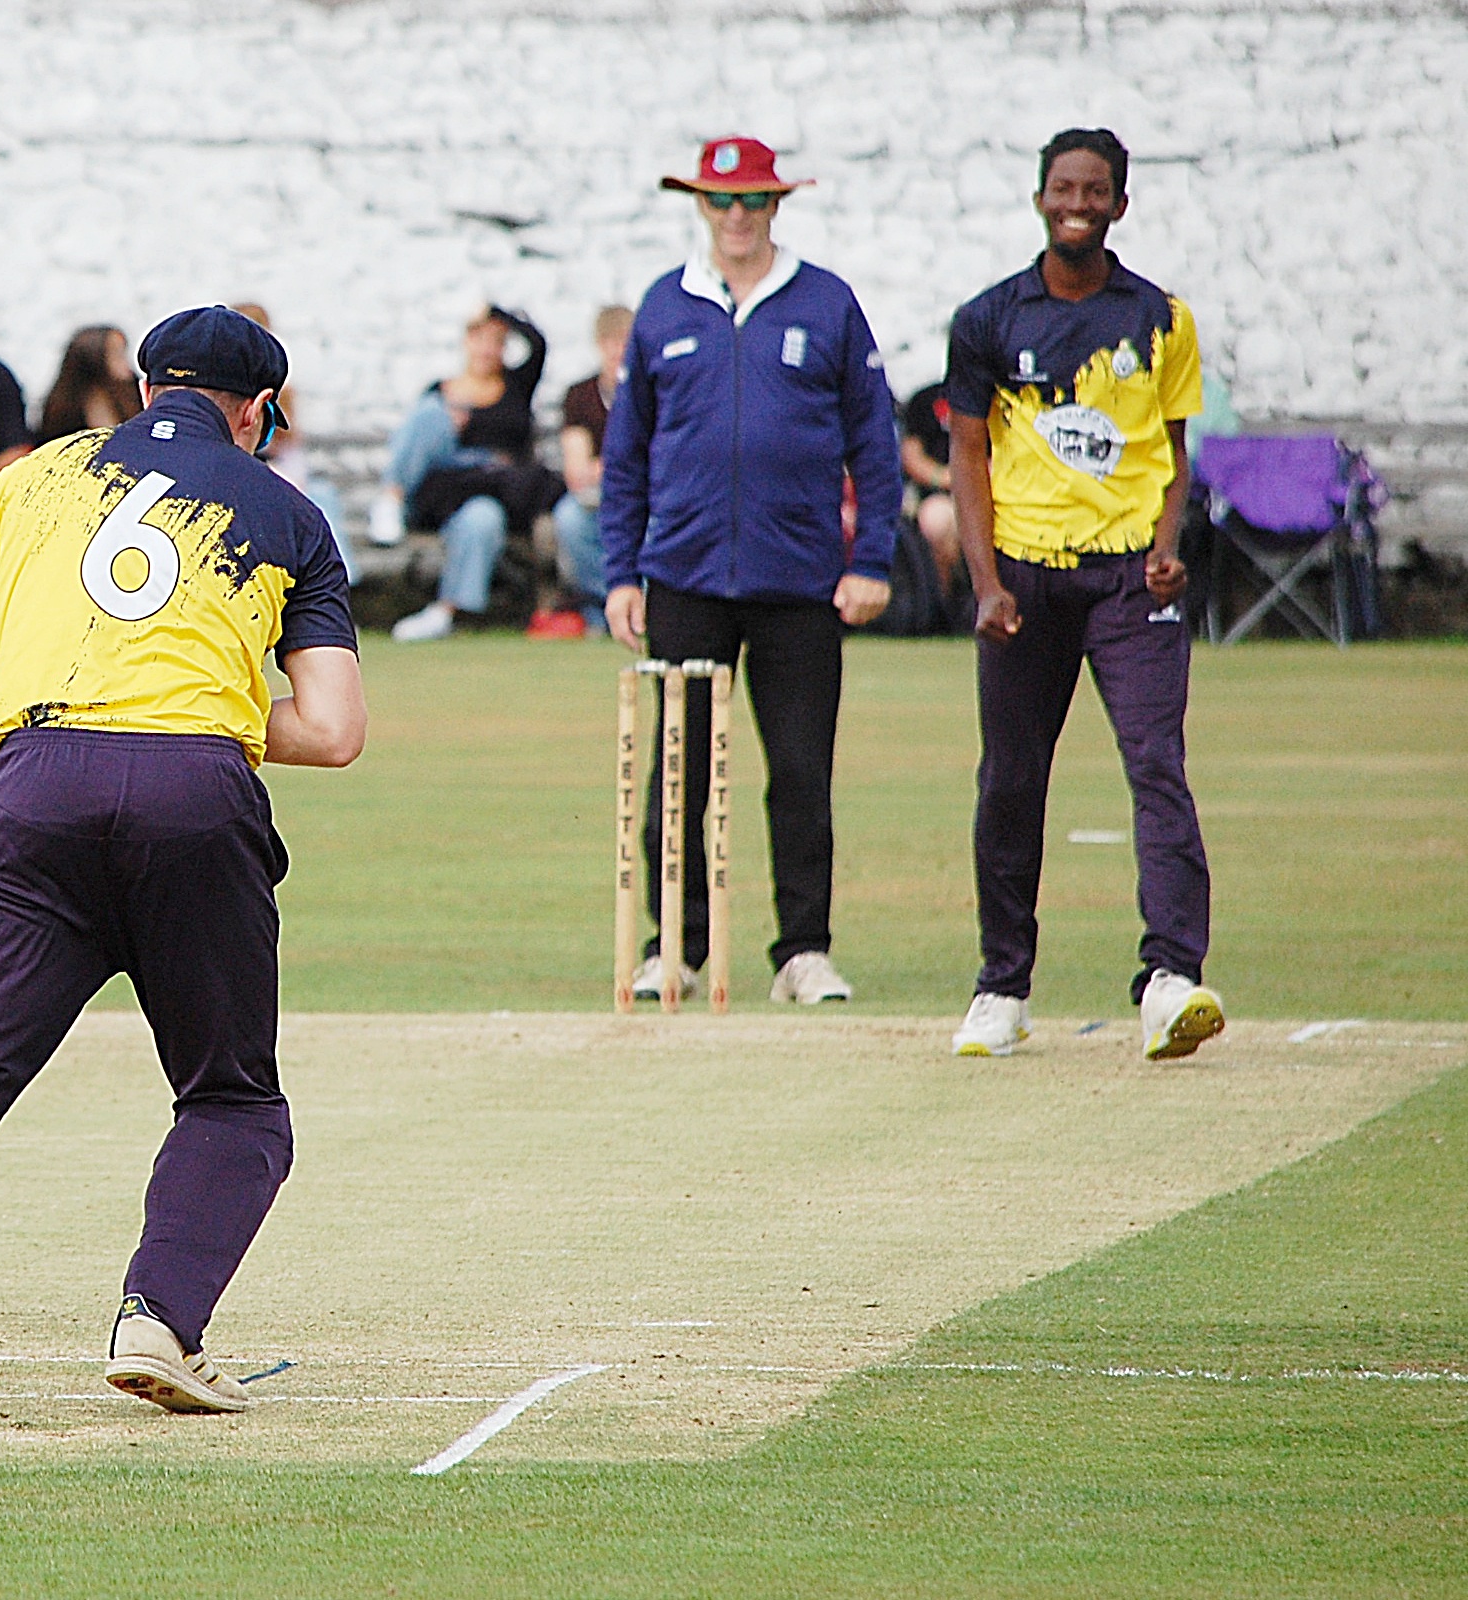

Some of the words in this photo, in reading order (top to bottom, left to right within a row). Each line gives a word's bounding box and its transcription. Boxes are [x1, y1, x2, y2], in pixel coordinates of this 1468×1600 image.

[81, 469, 181, 622] 6
[618, 733, 633, 889] SETTLE
[666, 727, 680, 882] SETTLE
[714, 732, 727, 889] SETTLE
